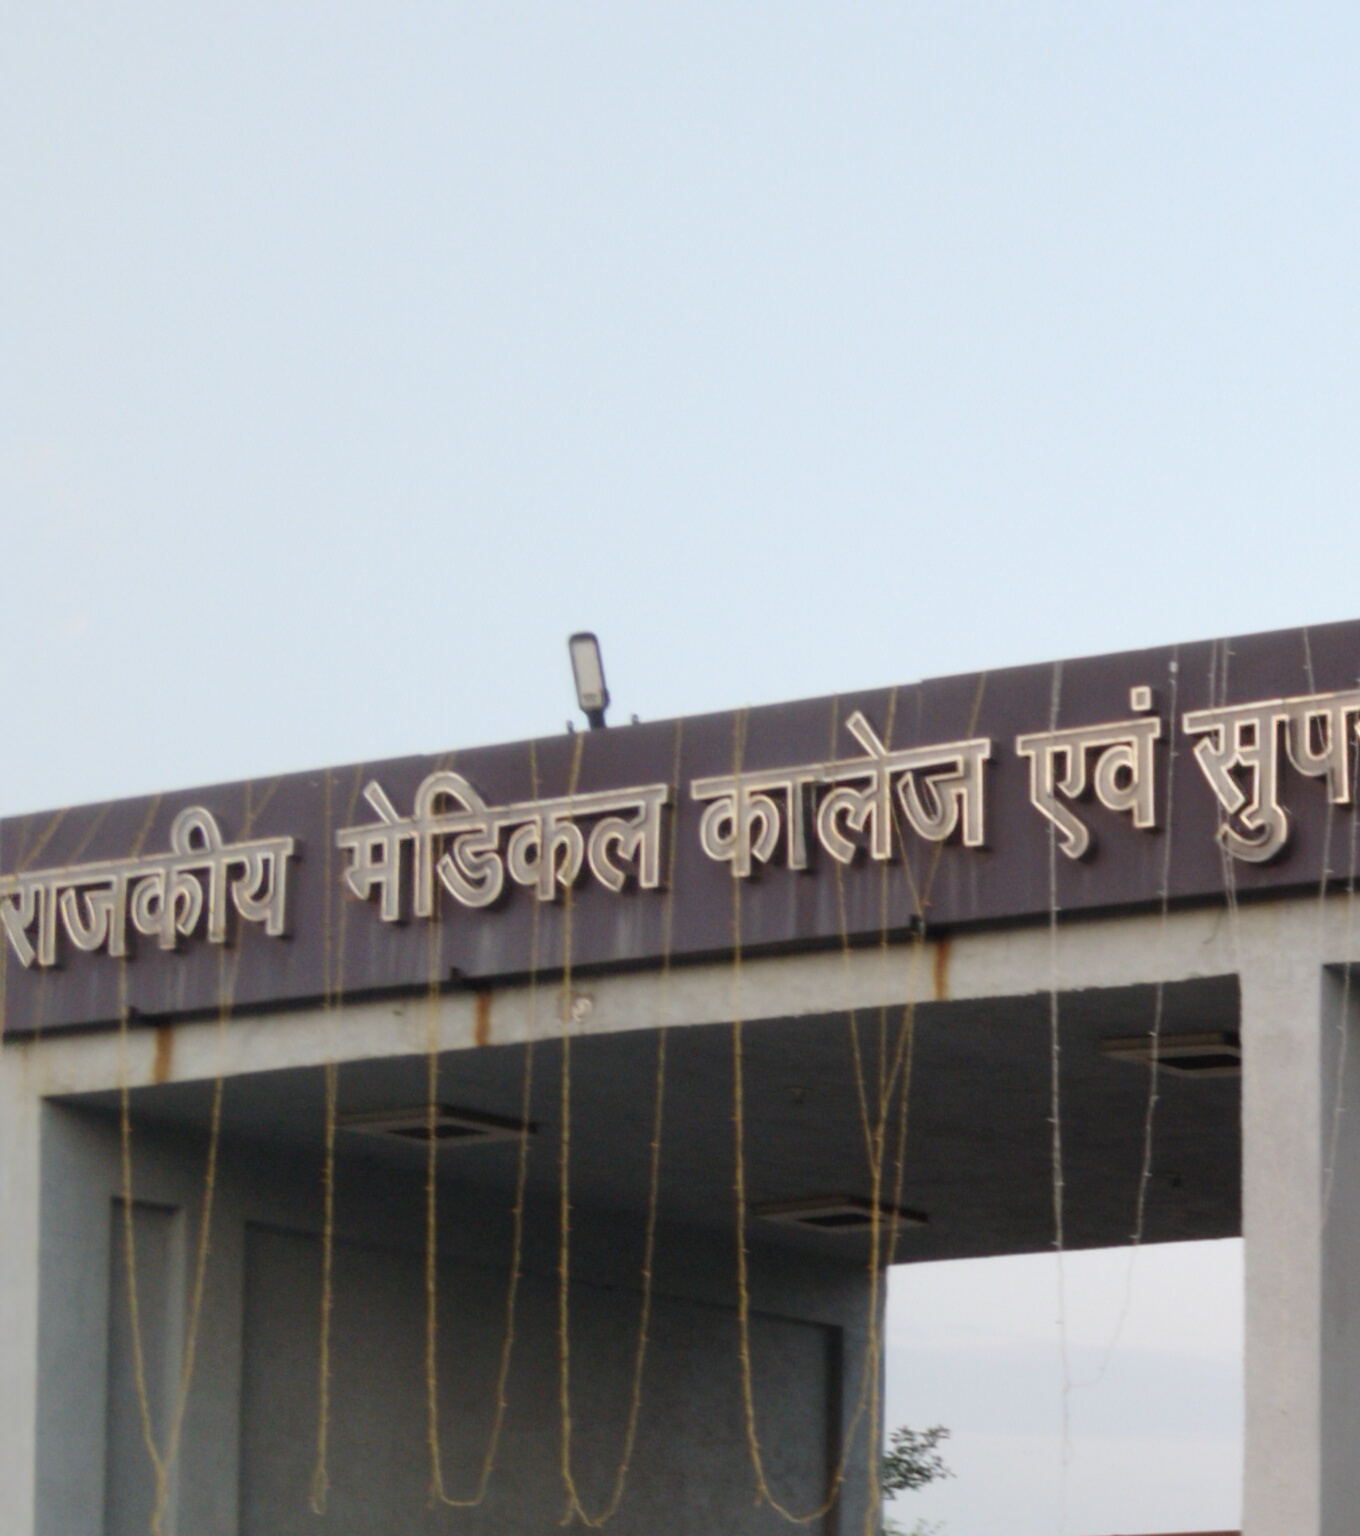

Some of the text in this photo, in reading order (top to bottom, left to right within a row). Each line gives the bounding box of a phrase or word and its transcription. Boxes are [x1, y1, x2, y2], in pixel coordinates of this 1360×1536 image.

[0, 805, 294, 968] राजकीय
[336, 770, 669, 923] मेडिकल
[690, 710, 991, 878] कालेज
[1017, 686, 1161, 860] एवं
